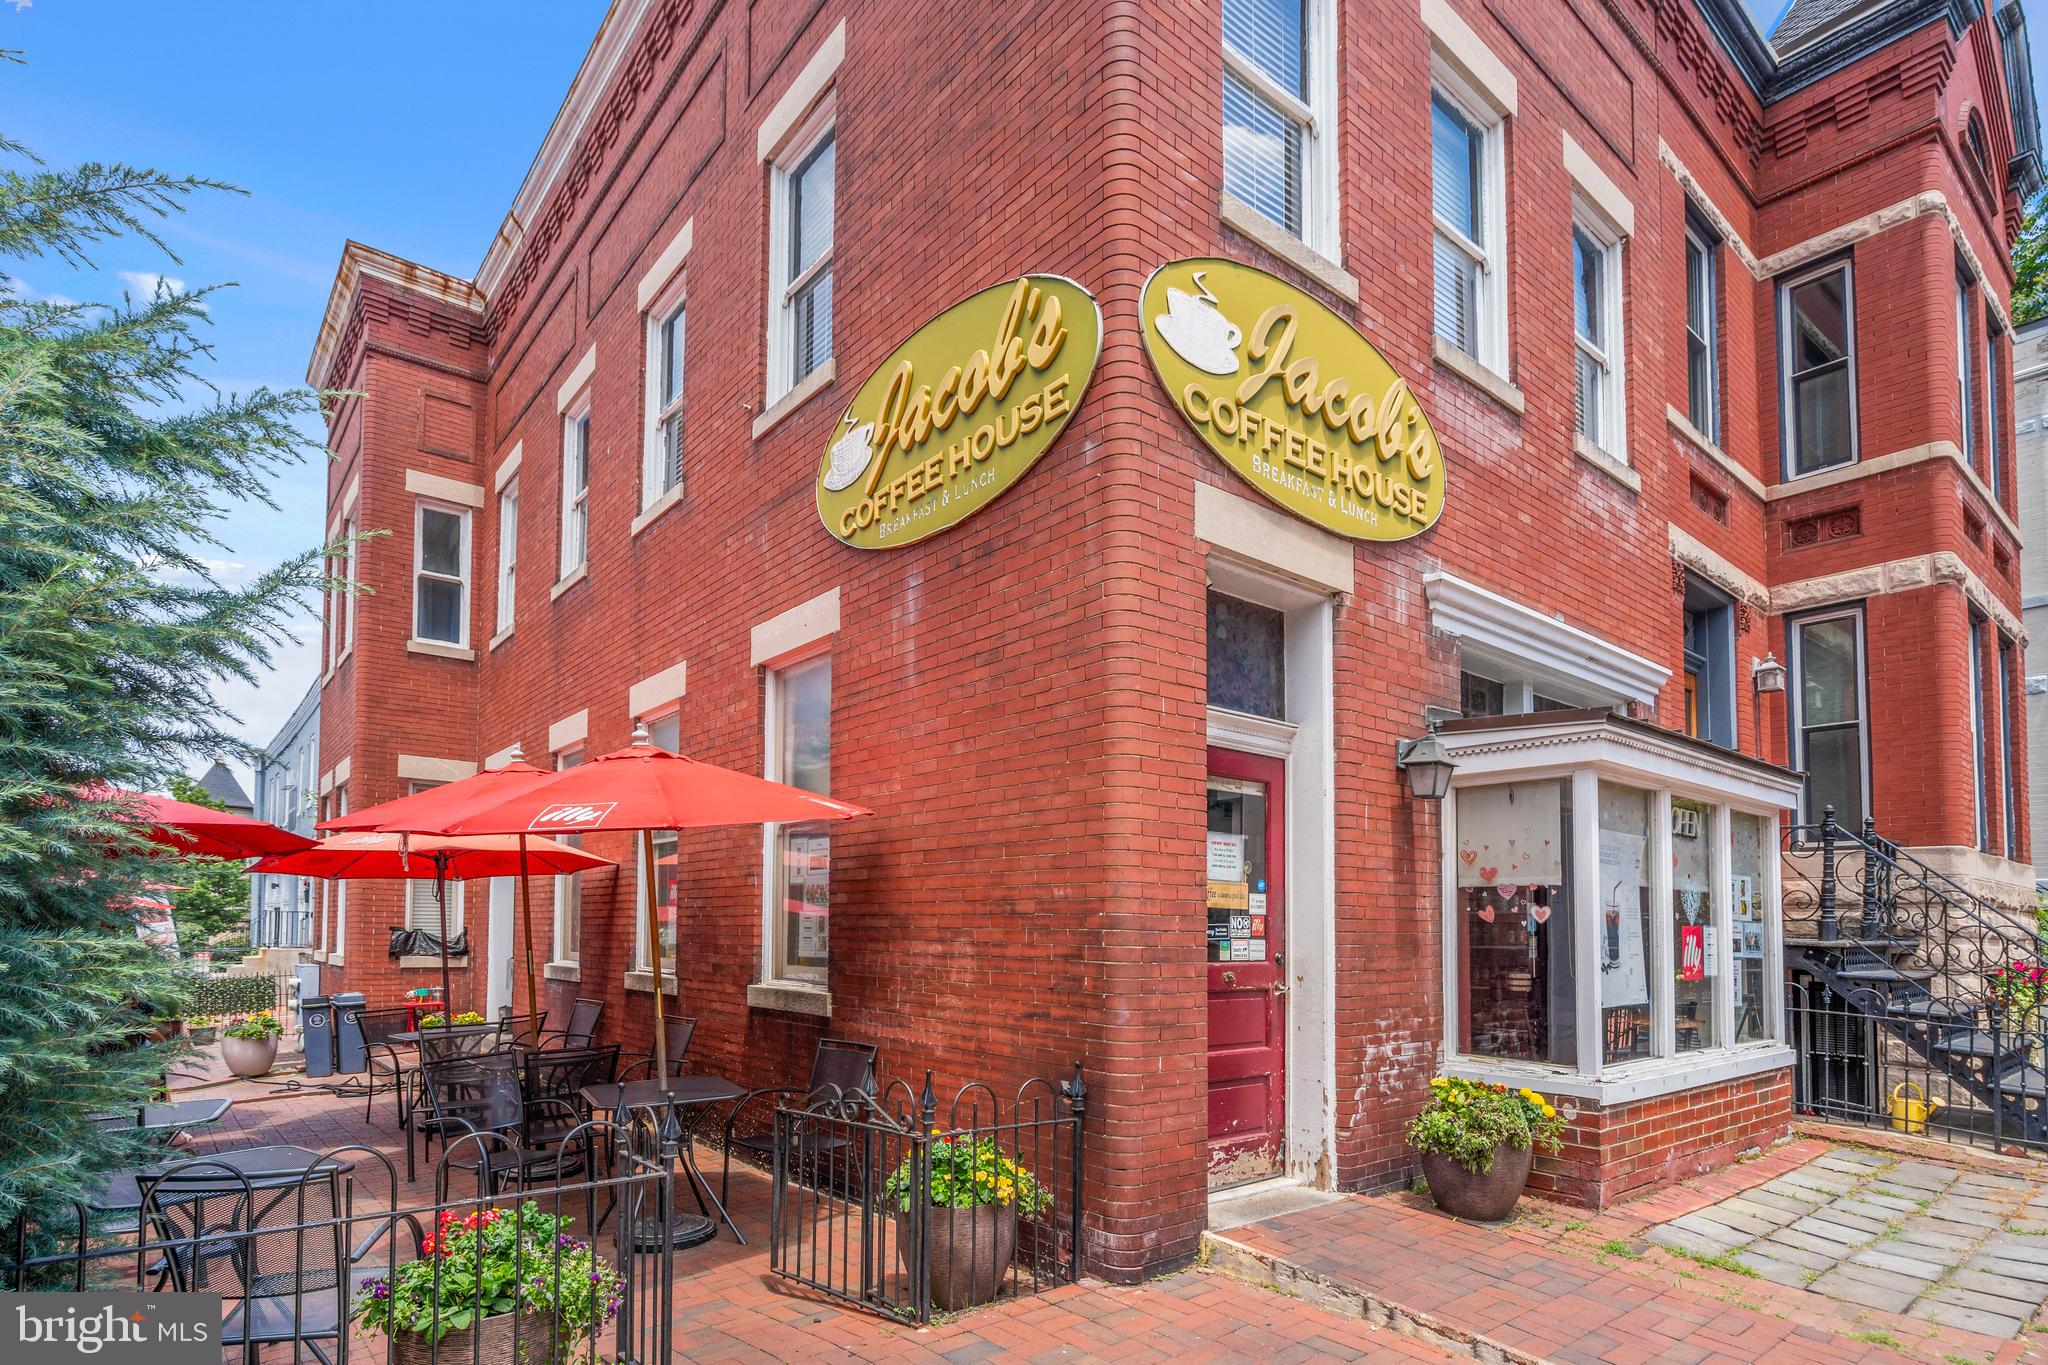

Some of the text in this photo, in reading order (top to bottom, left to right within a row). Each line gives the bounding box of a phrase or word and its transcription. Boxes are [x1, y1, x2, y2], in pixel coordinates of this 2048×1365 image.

[840, 374, 1070, 538] COFFEE HOUSE
[866, 278, 1067, 496] Jacob's
[1183, 383, 1428, 526] COFFEE HOUSE
[1236, 304, 1434, 480] Jacob's
[879, 468, 996, 539] BREAKFAST & LUNCH
[1252, 454, 1378, 527] BREAKFAST & LUNCH
[1683, 934, 1701, 975] illy
